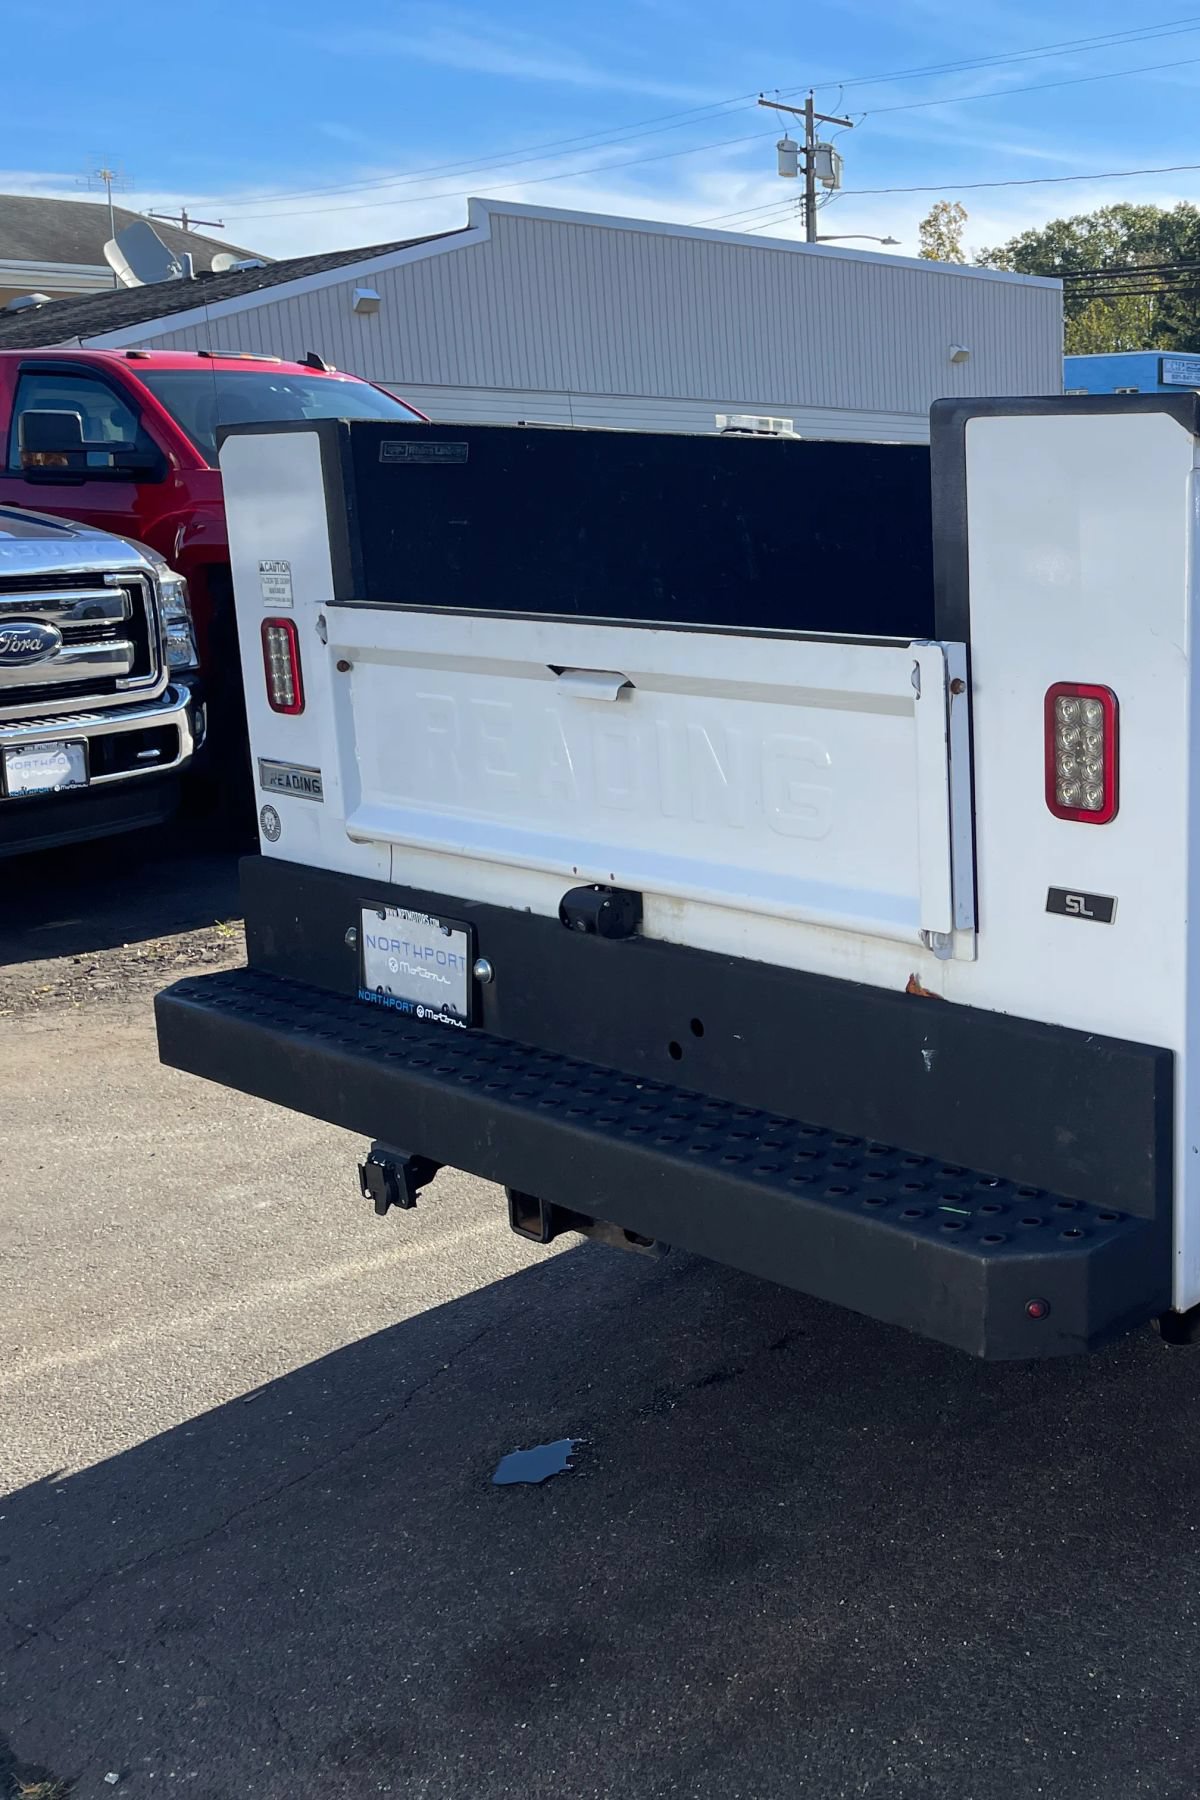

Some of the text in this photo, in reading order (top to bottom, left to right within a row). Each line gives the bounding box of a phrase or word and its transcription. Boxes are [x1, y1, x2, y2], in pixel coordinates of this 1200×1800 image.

[416, 692, 833, 841] READING
[270, 772, 321, 794] READING
[1065, 894, 1094, 917] SL
[366, 934, 466, 972] NORTHPORT
[359, 989, 415, 1014] NORTHPORT
